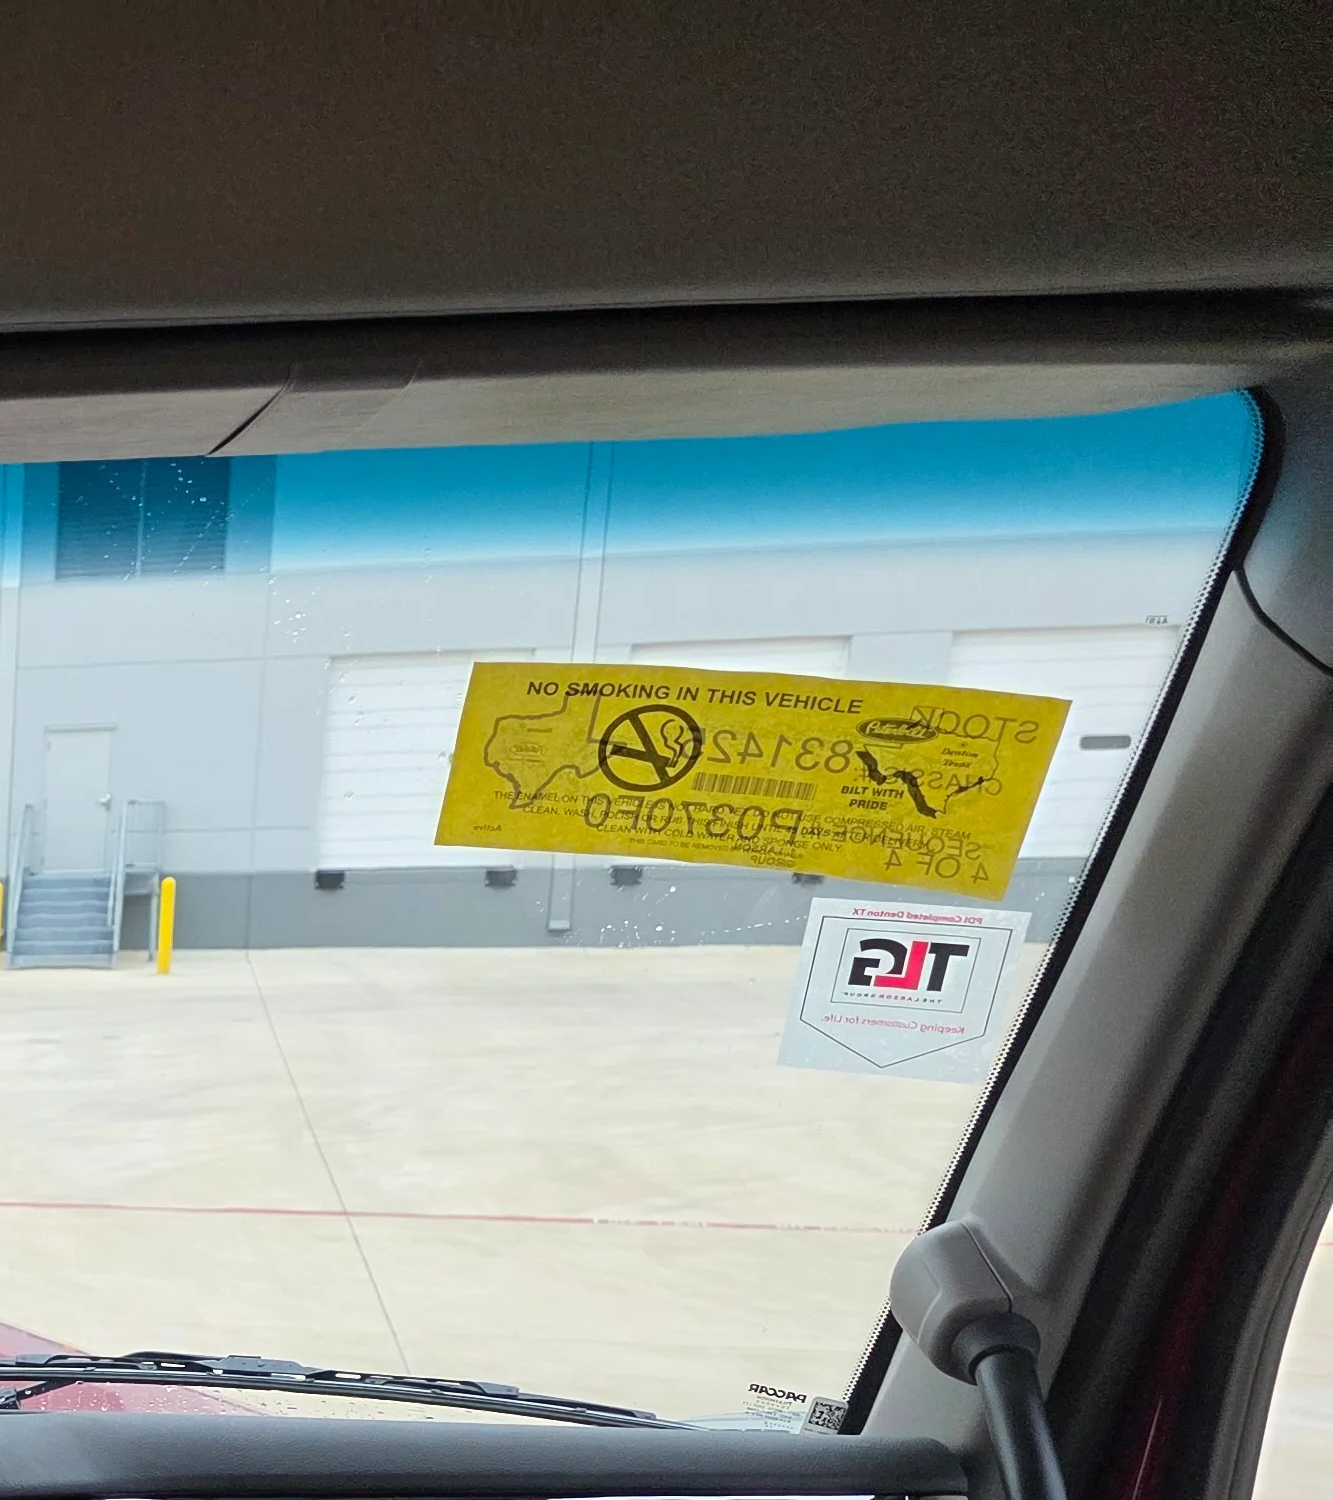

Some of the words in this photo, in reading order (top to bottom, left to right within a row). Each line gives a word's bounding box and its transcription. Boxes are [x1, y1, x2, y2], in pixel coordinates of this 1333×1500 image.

[527, 681, 559, 697] NO
[564, 682, 670, 700] SMOKING
[676, 687, 700, 702] IN
[707, 688, 756, 706] THIS
[764, 691, 864, 714] VEHICLE
[865, 719, 934, 741] Peterbilt
[841, 785, 869, 797] BILT
[871, 788, 905, 800] WITH
[494, 790, 514, 800] THE
[562, 795, 579, 804] ON
[824, 815, 906, 832] COMPRESSED
[932, 827, 972, 841] STEAM
[849, 799, 888, 812] PRIDE
[597, 824, 632, 834] CLEAN
[664, 828, 694, 839] COLD
[763, 837, 808, 851] SPONGE
